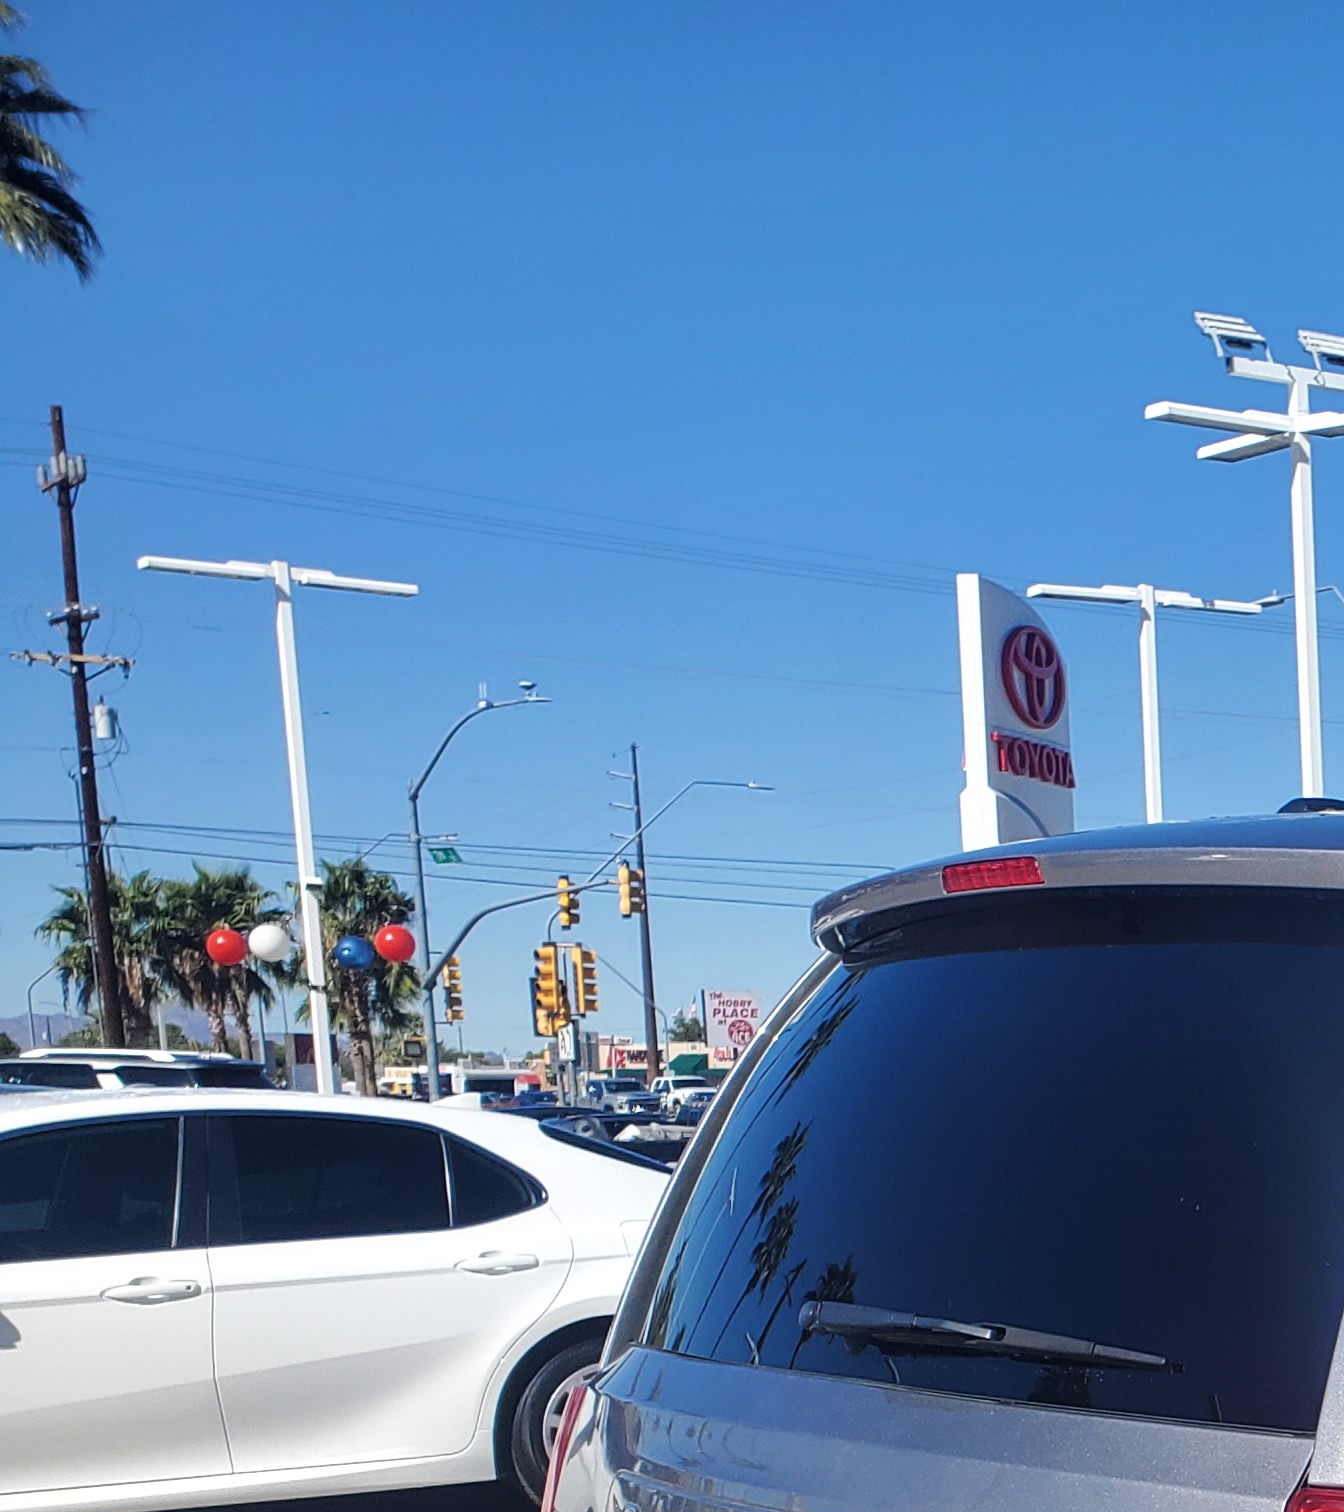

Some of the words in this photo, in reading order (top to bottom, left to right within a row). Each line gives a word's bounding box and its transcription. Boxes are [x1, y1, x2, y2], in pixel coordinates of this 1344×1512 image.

[991, 730, 1076, 788] TOYOTA
[709, 991, 723, 1000] The
[712, 1008, 758, 1018] PLACE
